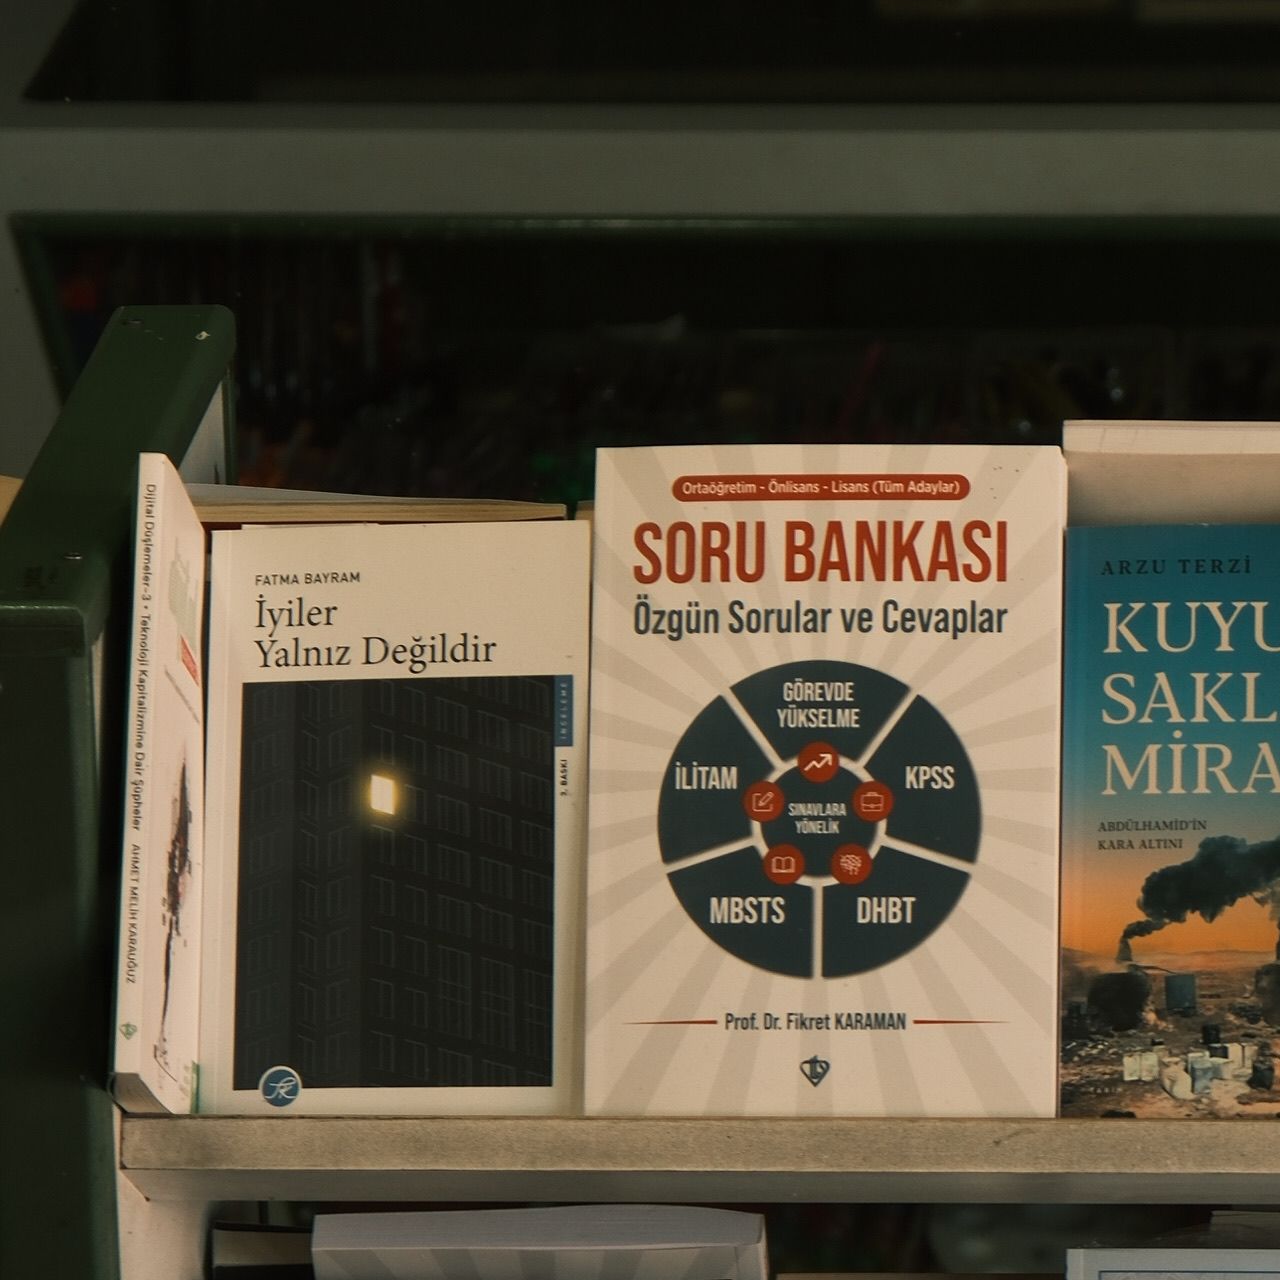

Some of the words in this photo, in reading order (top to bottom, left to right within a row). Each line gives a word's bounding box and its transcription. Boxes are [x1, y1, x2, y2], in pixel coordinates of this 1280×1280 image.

[682, 480, 757, 496] Ortaöğretim
[768, 478, 820, 494] Önlisans
[831, 480, 870, 494] Lisans
[872, 479, 904, 495] (Tüm
[907, 479, 960, 496] Adaylar)
[143, 484, 157, 519] Dijital
[633, 521, 765, 584] SORU
[785, 520, 1007, 582] BANKASI
[1101, 559, 1166, 575] ARZU
[1178, 555, 1250, 574] TERZİ
[255, 574, 299, 586] FATMA
[304, 572, 361, 585] BAYRAM
[255, 593, 338, 638] İyiler
[634, 593, 719, 641] Özgün
[728, 600, 832, 634] Sorular
[840, 608, 873, 633] ve
[882, 599, 1008, 640] Cevaplar
[136, 615, 152, 666] Teknoloji
[254, 637, 351, 668] Yalnız
[362, 632, 497, 674] Değildir
[783, 678, 854, 702] GÖREVDE
[134, 670, 148, 750] Kapitalizmine
[777, 704, 860, 728] YÜKSELME
[134, 752, 145, 776] Dair
[675, 761, 738, 790] İLİTAM
[905, 765, 955, 790] KPSS
[788, 802, 847, 817] SINAVLARA
[795, 818, 840, 834] YÖNELİK
[1098, 839, 1135, 851] KARA
[1138, 838, 1183, 850] ALTINI
[129, 844, 141, 881] AHMET
[709, 896, 785, 924] MBSTS
[856, 896, 916, 924] DHBT
[725, 1012, 759, 1030] Prof.
[764, 1013, 781, 1030] Dr.
[786, 1012, 830, 1030] Fikret
[834, 1012, 906, 1030] KARAMAN
